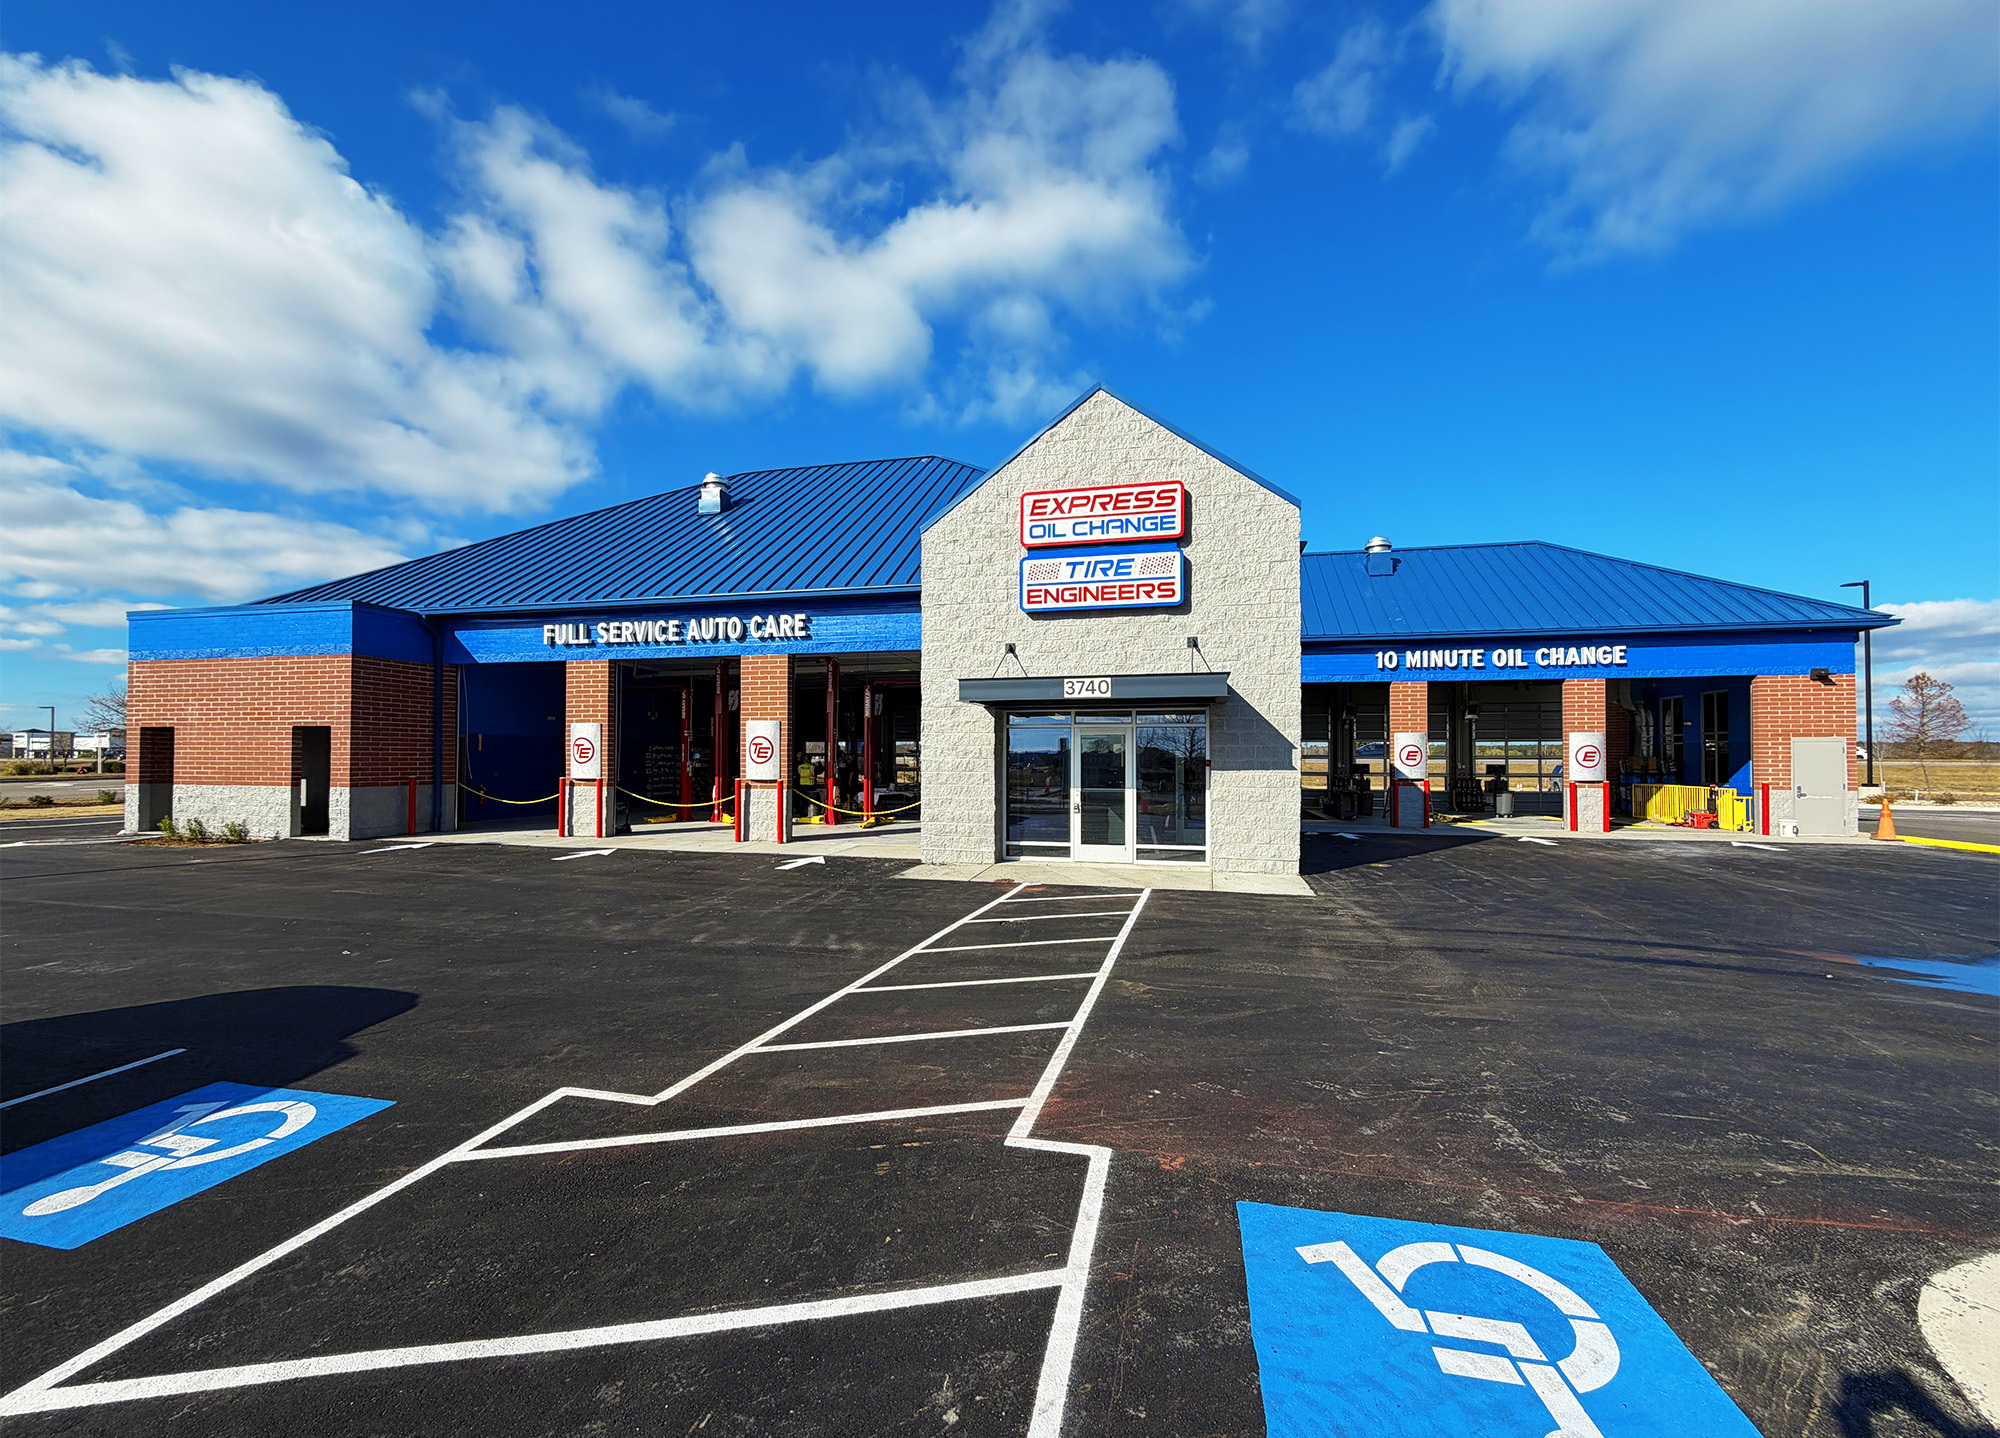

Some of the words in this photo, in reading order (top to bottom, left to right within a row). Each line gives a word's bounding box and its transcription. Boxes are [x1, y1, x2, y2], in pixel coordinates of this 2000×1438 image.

[1029, 488, 1178, 516] EXPRESS
[1029, 523, 1067, 539] OIL
[1072, 515, 1176, 537] CHANGE
[1066, 558, 1135, 579] TIRE
[1027, 582, 1176, 605] ENGINEERS
[543, 623, 589, 645] FULL
[597, 620, 681, 643] SERVICE
[687, 616, 742, 641] AUTO
[750, 613, 806, 638] CARE
[1375, 651, 1398, 669] 10
[1406, 648, 1485, 668] MINUTE
[1492, 648, 1528, 667] OIL
[1535, 645, 1627, 667] CHANGE
[1065, 679, 1110, 696] 3740
[575, 743, 591, 759] TE
[751, 742, 771, 758] TE
[1405, 750, 1419, 761] E
[1582, 751, 1597, 762] E
